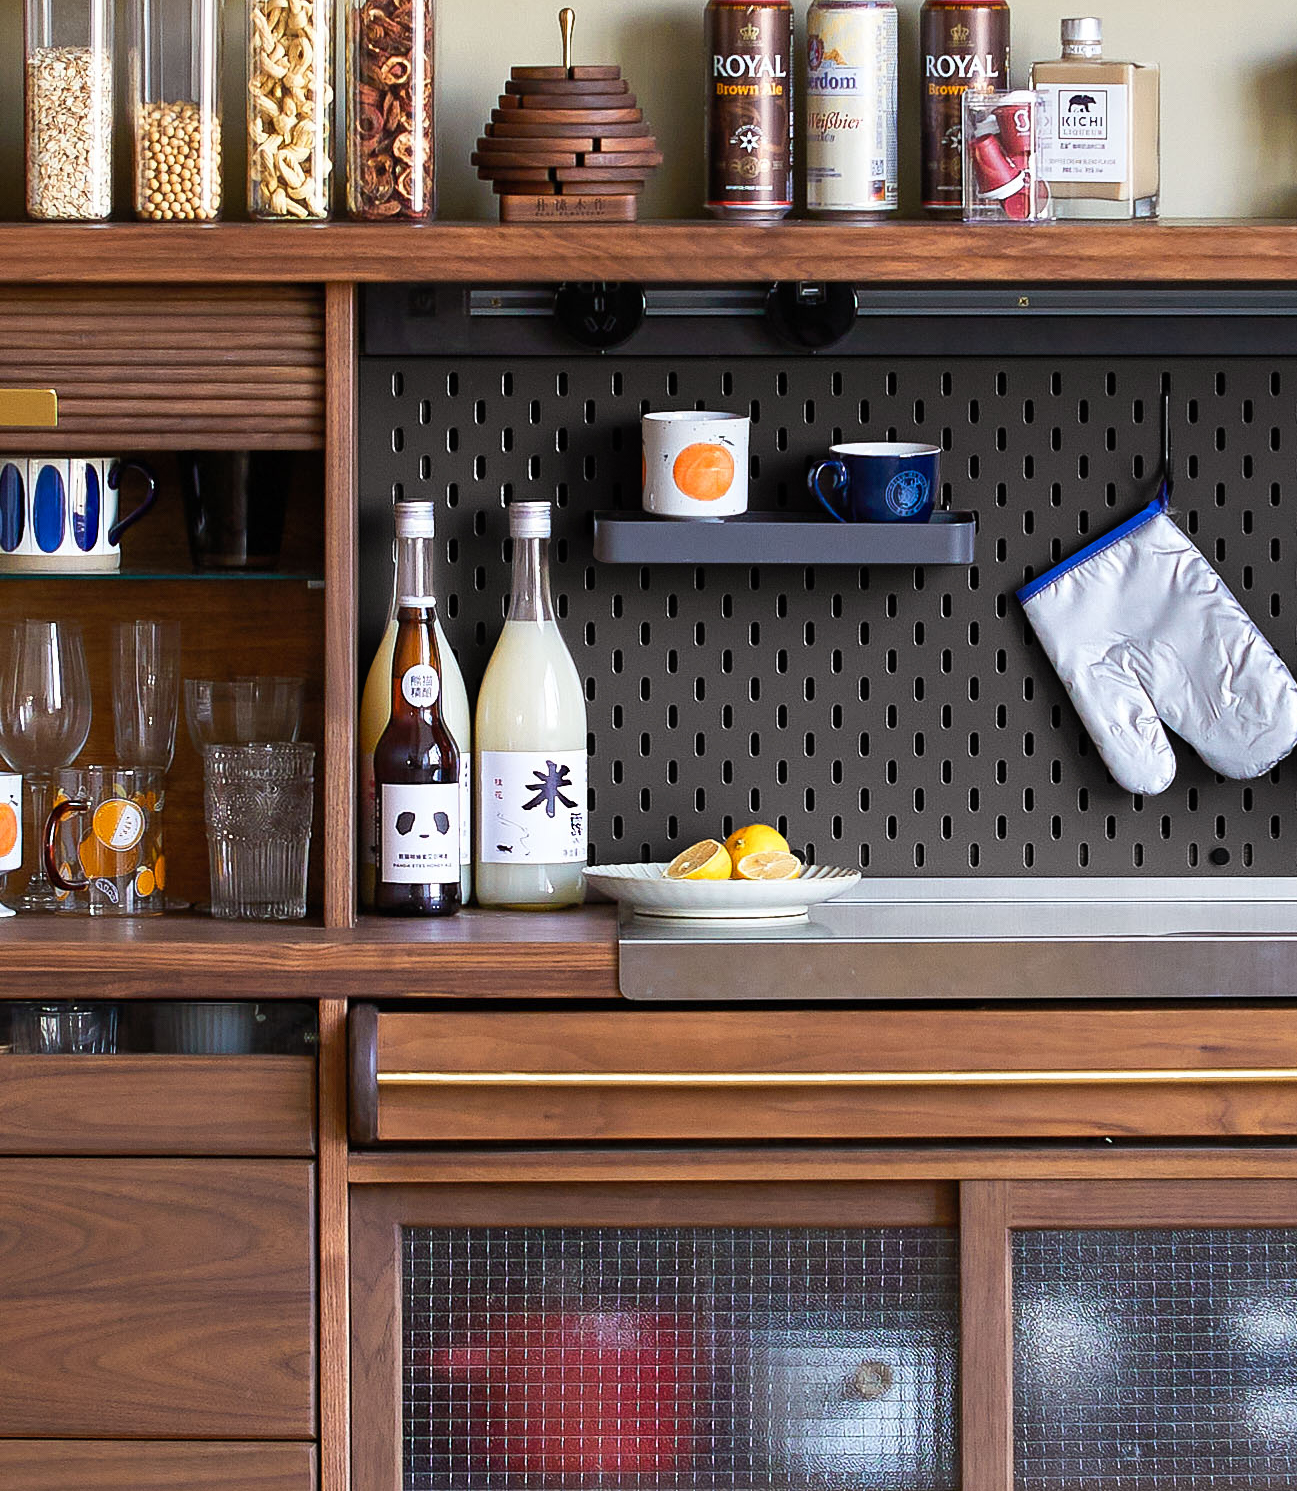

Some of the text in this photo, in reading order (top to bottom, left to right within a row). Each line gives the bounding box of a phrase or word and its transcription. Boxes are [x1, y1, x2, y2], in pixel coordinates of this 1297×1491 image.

[713, 55, 786, 78] ROYAL
[926, 55, 999, 78] ROYAL
[716, 83, 782, 96] Brown Ale
[928, 83, 968, 96] Brown
[1062, 116, 1103, 126] KICHI
[521, 759, 579, 819] 米
